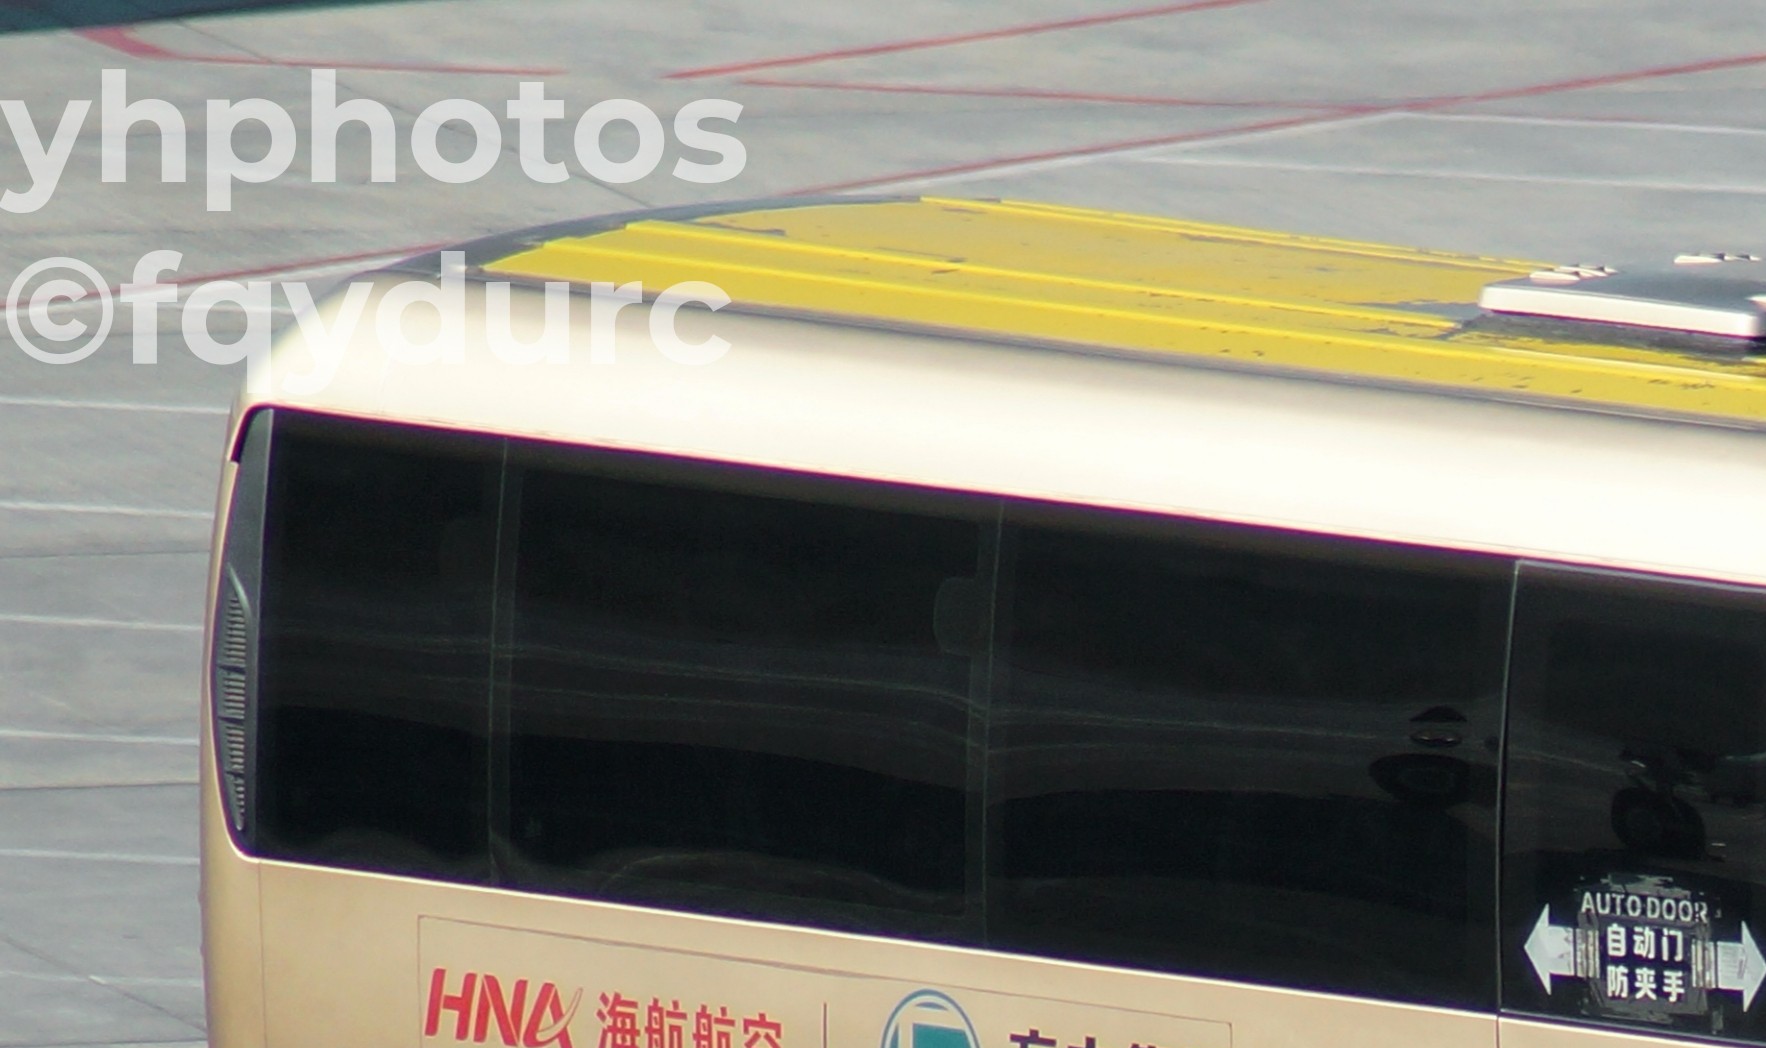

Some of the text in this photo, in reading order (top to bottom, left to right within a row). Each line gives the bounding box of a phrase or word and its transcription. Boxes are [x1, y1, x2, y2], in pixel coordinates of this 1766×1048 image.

[1607, 923, 1684, 962] 自动门
[1607, 965, 1685, 1003] 防夹手
